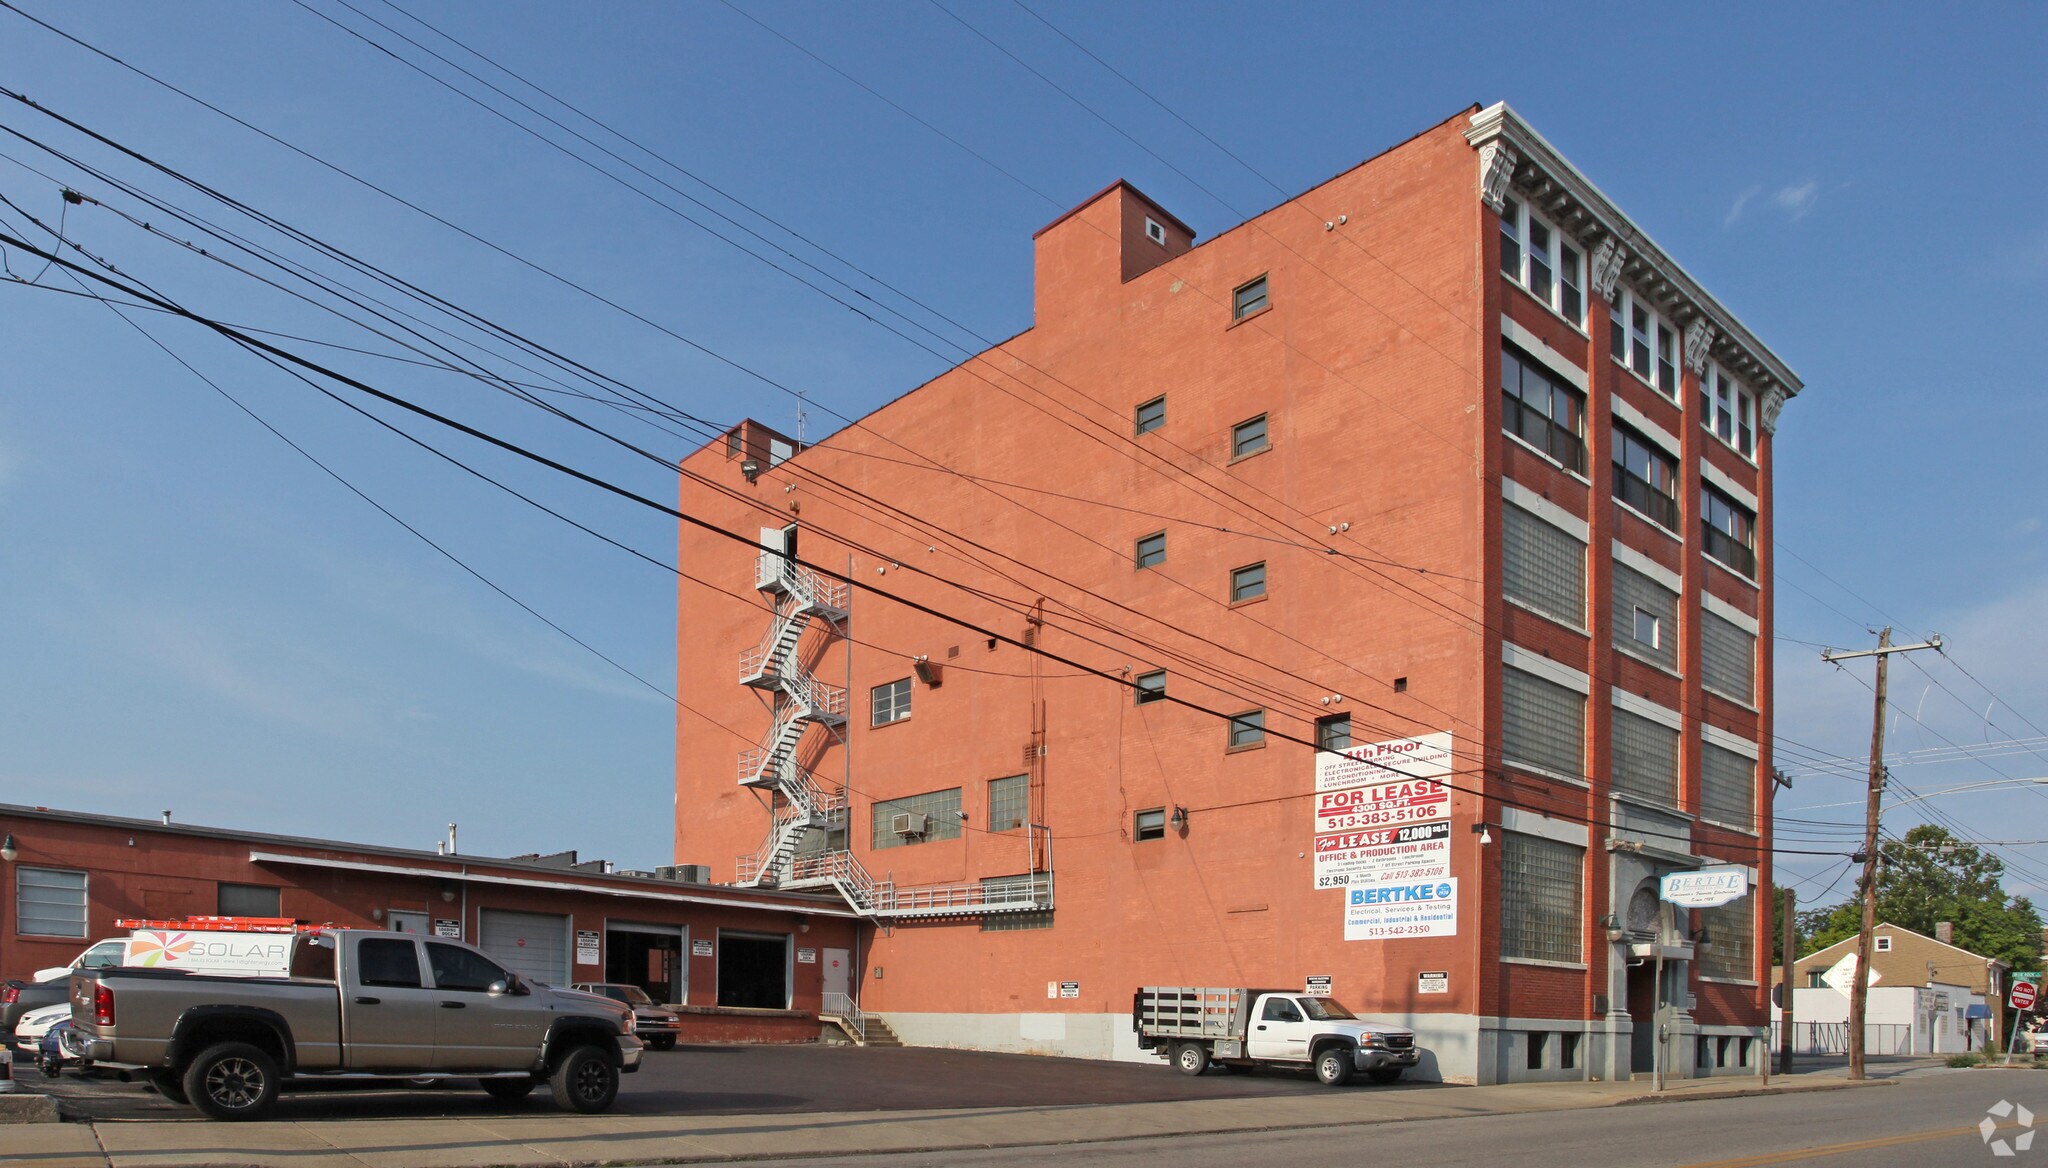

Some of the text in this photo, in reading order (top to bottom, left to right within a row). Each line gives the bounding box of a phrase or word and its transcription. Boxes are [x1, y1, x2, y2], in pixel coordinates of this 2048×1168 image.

[1344, 741, 1422, 761] 4th Floor
[1383, 759, 1411, 767] SECURE
[1324, 772, 1399, 788] LUNCHROOM MORE
[1337, 769, 1386, 780] CONDITIONING
[1322, 779, 1443, 808] FOR LEASE
[1352, 804, 1376, 813] 4300
[1328, 805, 1437, 829] 513-383-5106
[1318, 838, 1336, 851] For
[1338, 830, 1391, 849] LEASE
[1398, 826, 1433, 842] 12,000
[1319, 841, 1444, 863] OFFICE & PRODUCTION AREA
[1319, 874, 1350, 887] $2,950
[1380, 866, 1444, 881] Call 513-383-5106
[1669, 875, 1740, 891] BERTKE
[1350, 883, 1434, 905] BERTKE
[1385, 906, 1415, 914] Services
[1425, 903, 1451, 911] Testing
[1383, 915, 1412, 923] Industrial
[1420, 912, 1453, 921] Residential
[1368, 925, 1430, 936] 513-542-2350
[188, 942, 285, 958] SOLAR
[2014, 997, 2030, 1005] ENTER
